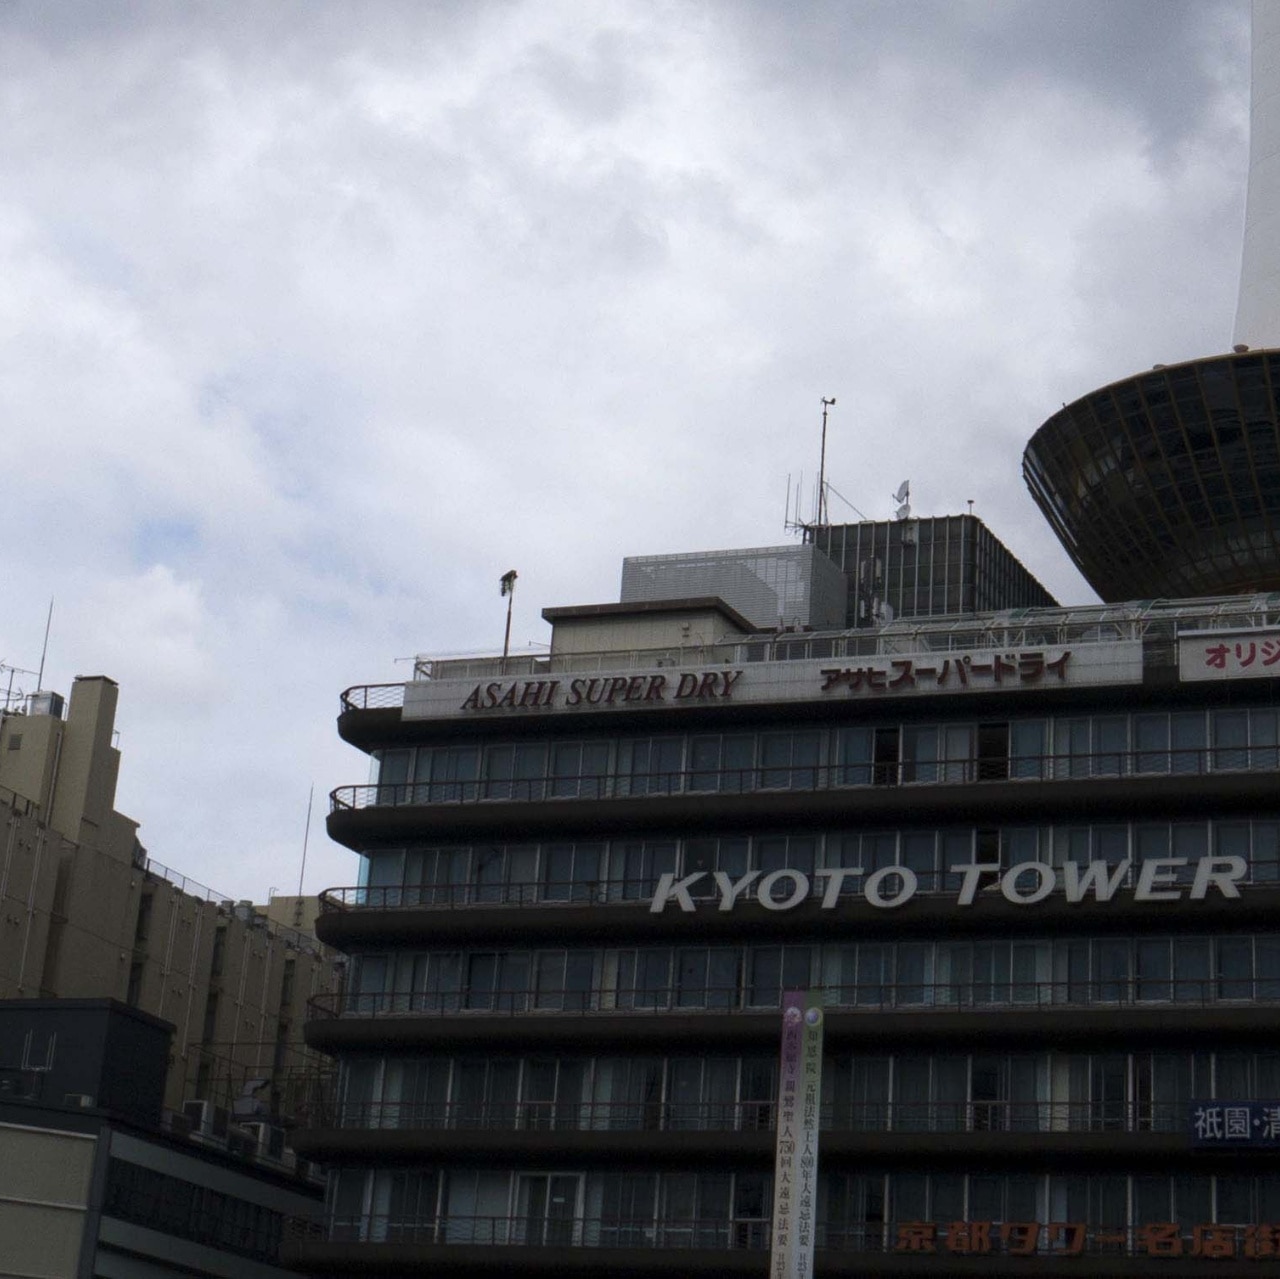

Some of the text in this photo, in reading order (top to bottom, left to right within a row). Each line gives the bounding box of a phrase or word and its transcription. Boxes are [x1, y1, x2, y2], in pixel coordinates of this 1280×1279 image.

[460, 670, 743, 710] ASAHI SUPER DRY
[820, 651, 1071, 690] アサヒスーパードライ
[648, 865, 918, 913] KYOTO
[950, 855, 1244, 906] TOWER
